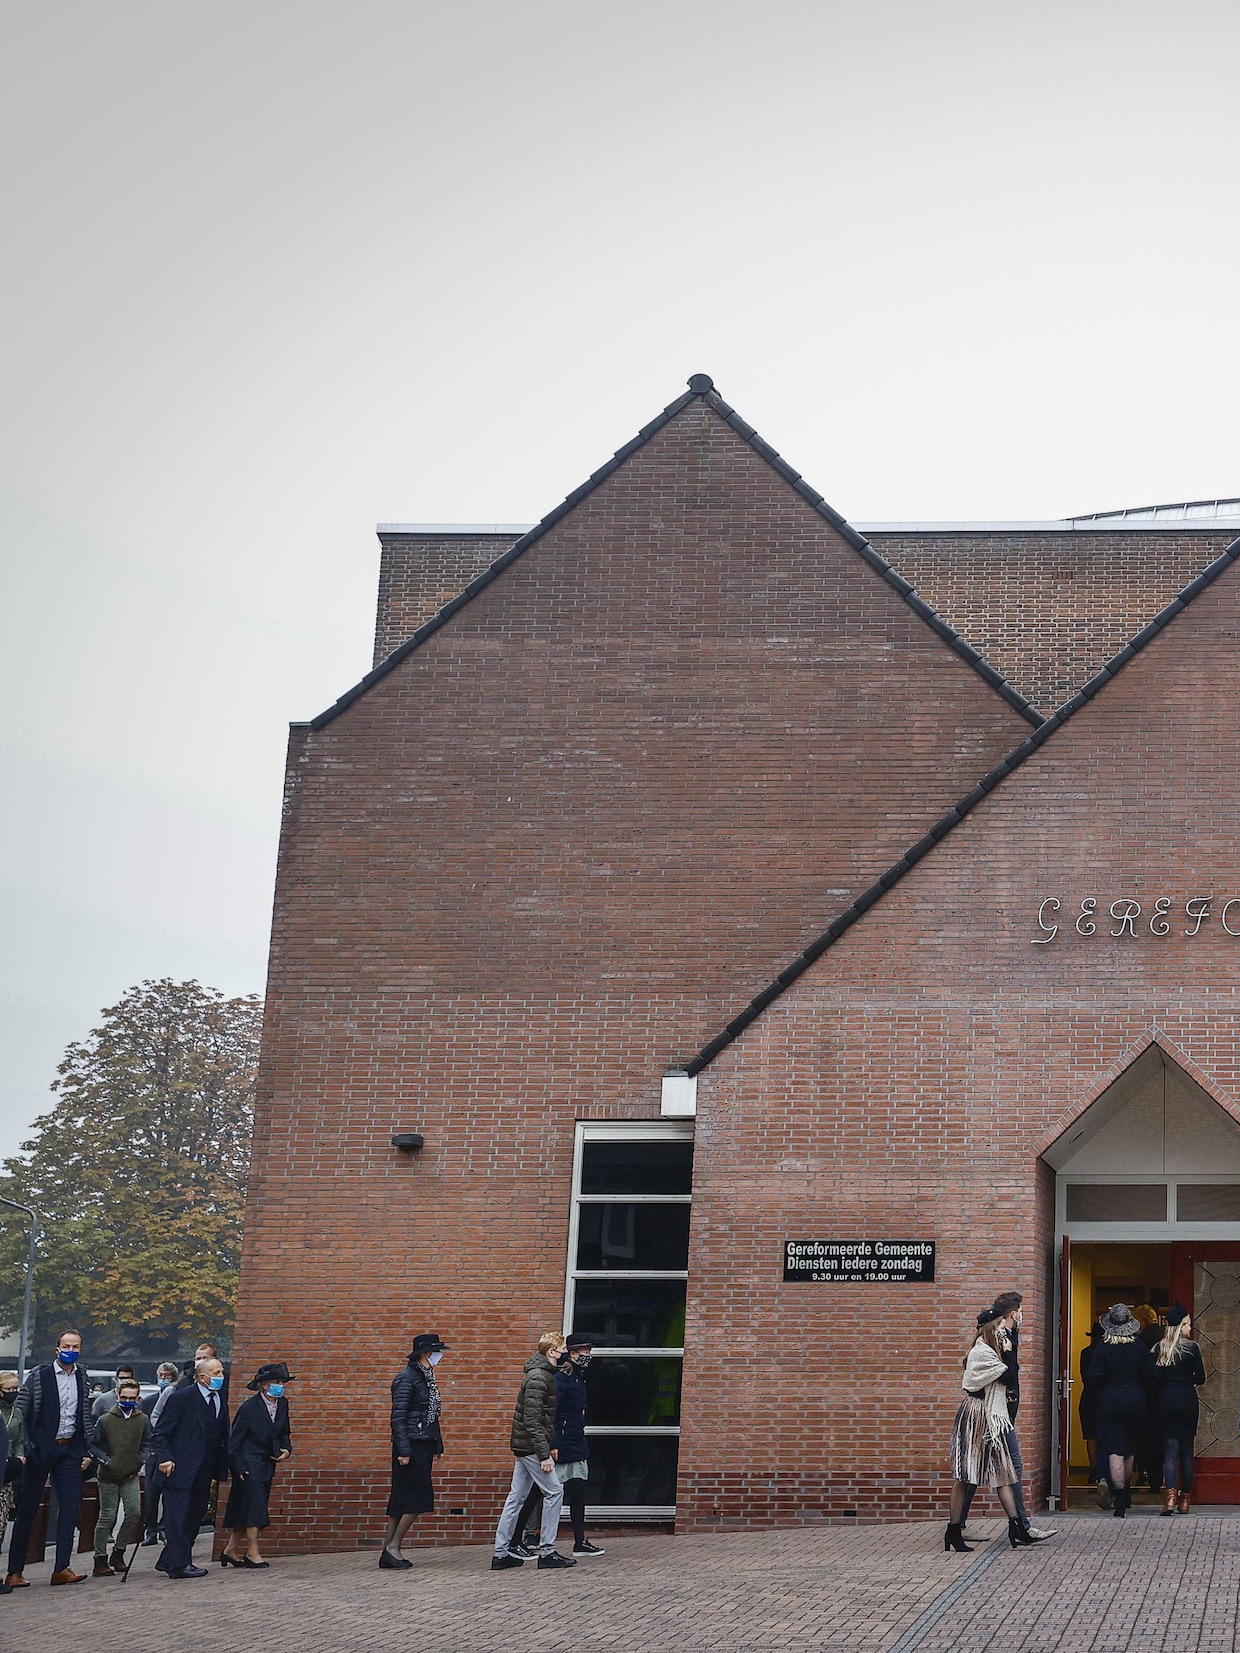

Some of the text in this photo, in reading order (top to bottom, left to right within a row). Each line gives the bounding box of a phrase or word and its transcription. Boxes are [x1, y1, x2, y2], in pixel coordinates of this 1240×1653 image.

[787, 1242, 932, 1256] Gereformeerde Gemeente
[787, 1256, 922, 1272] Diensten iedere zondag
[812, 1273, 831, 1281] 9.30
[864, 1273, 889, 1281] 19.00
